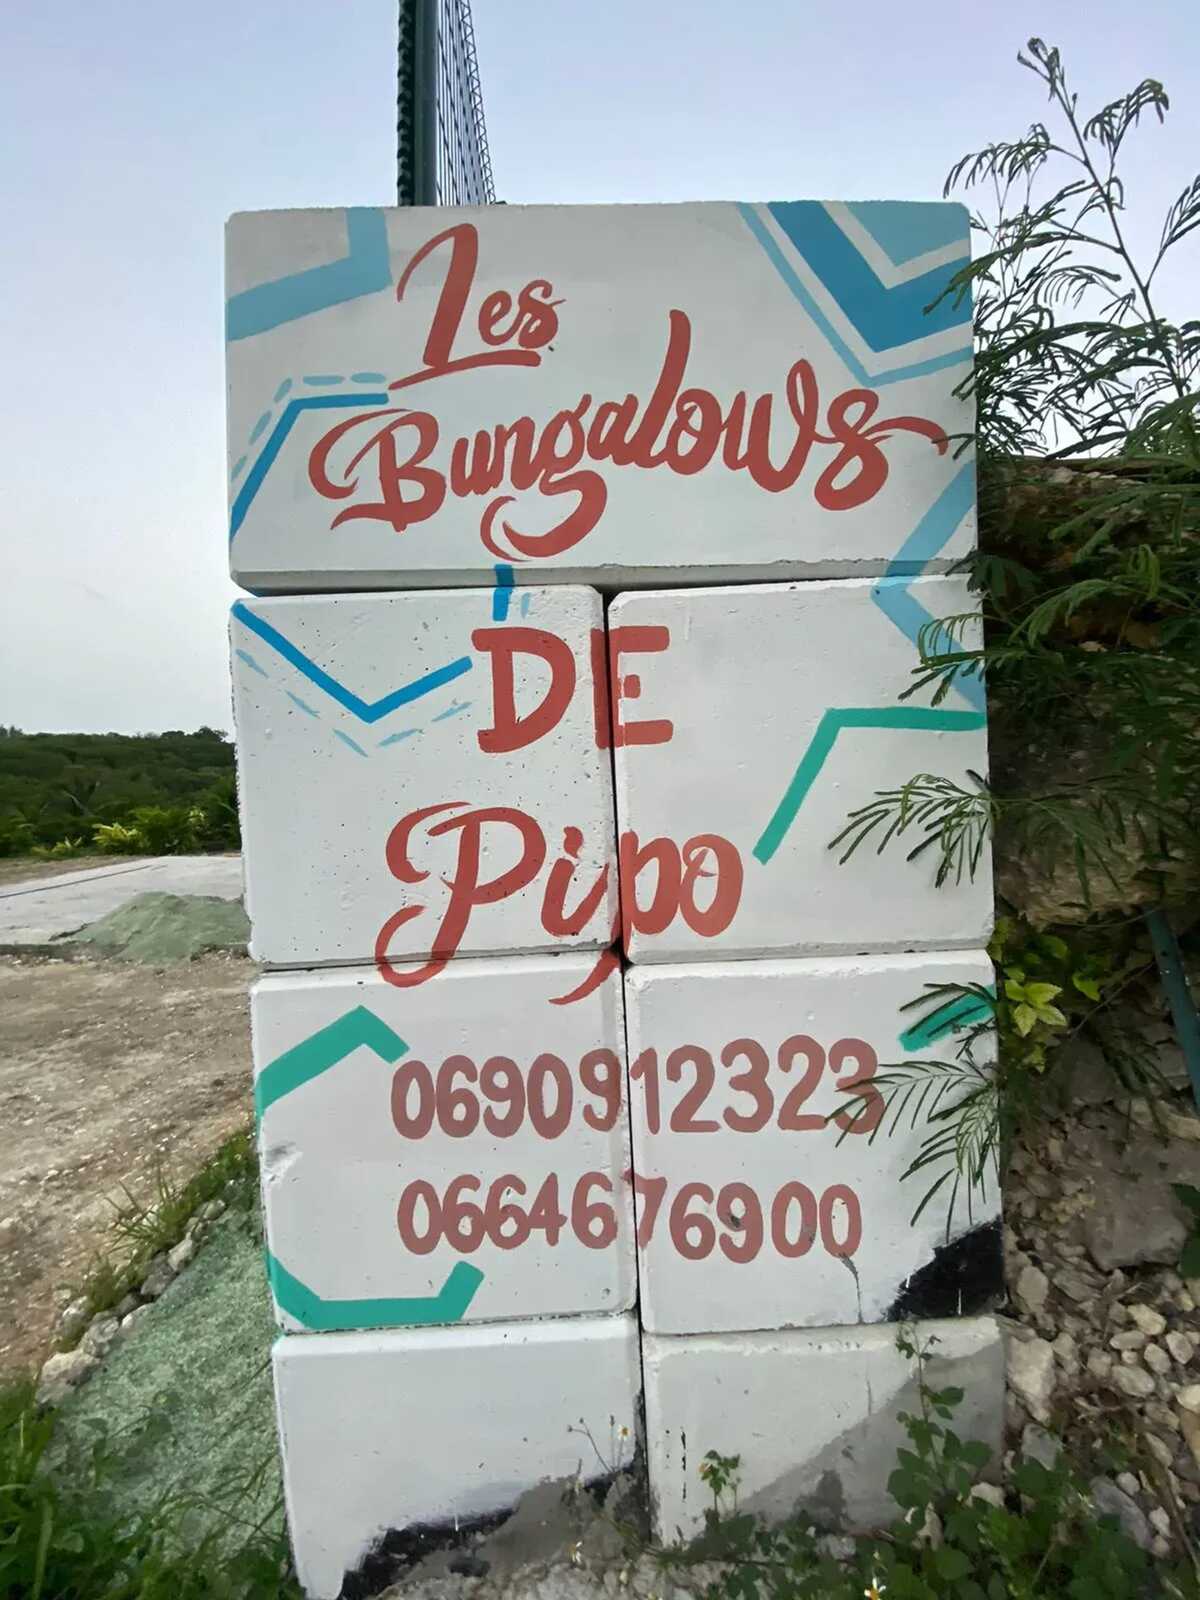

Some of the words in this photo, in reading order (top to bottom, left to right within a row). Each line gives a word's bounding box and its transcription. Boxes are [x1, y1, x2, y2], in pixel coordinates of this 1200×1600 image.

[388, 223, 564, 390] Les
[308, 310, 949, 562] Bungalows
[471, 625, 674, 754] DE
[374, 802, 744, 1006] Pipo
[390, 1035, 884, 1140] 0690912323
[397, 1172, 863, 1264] 0664676900
